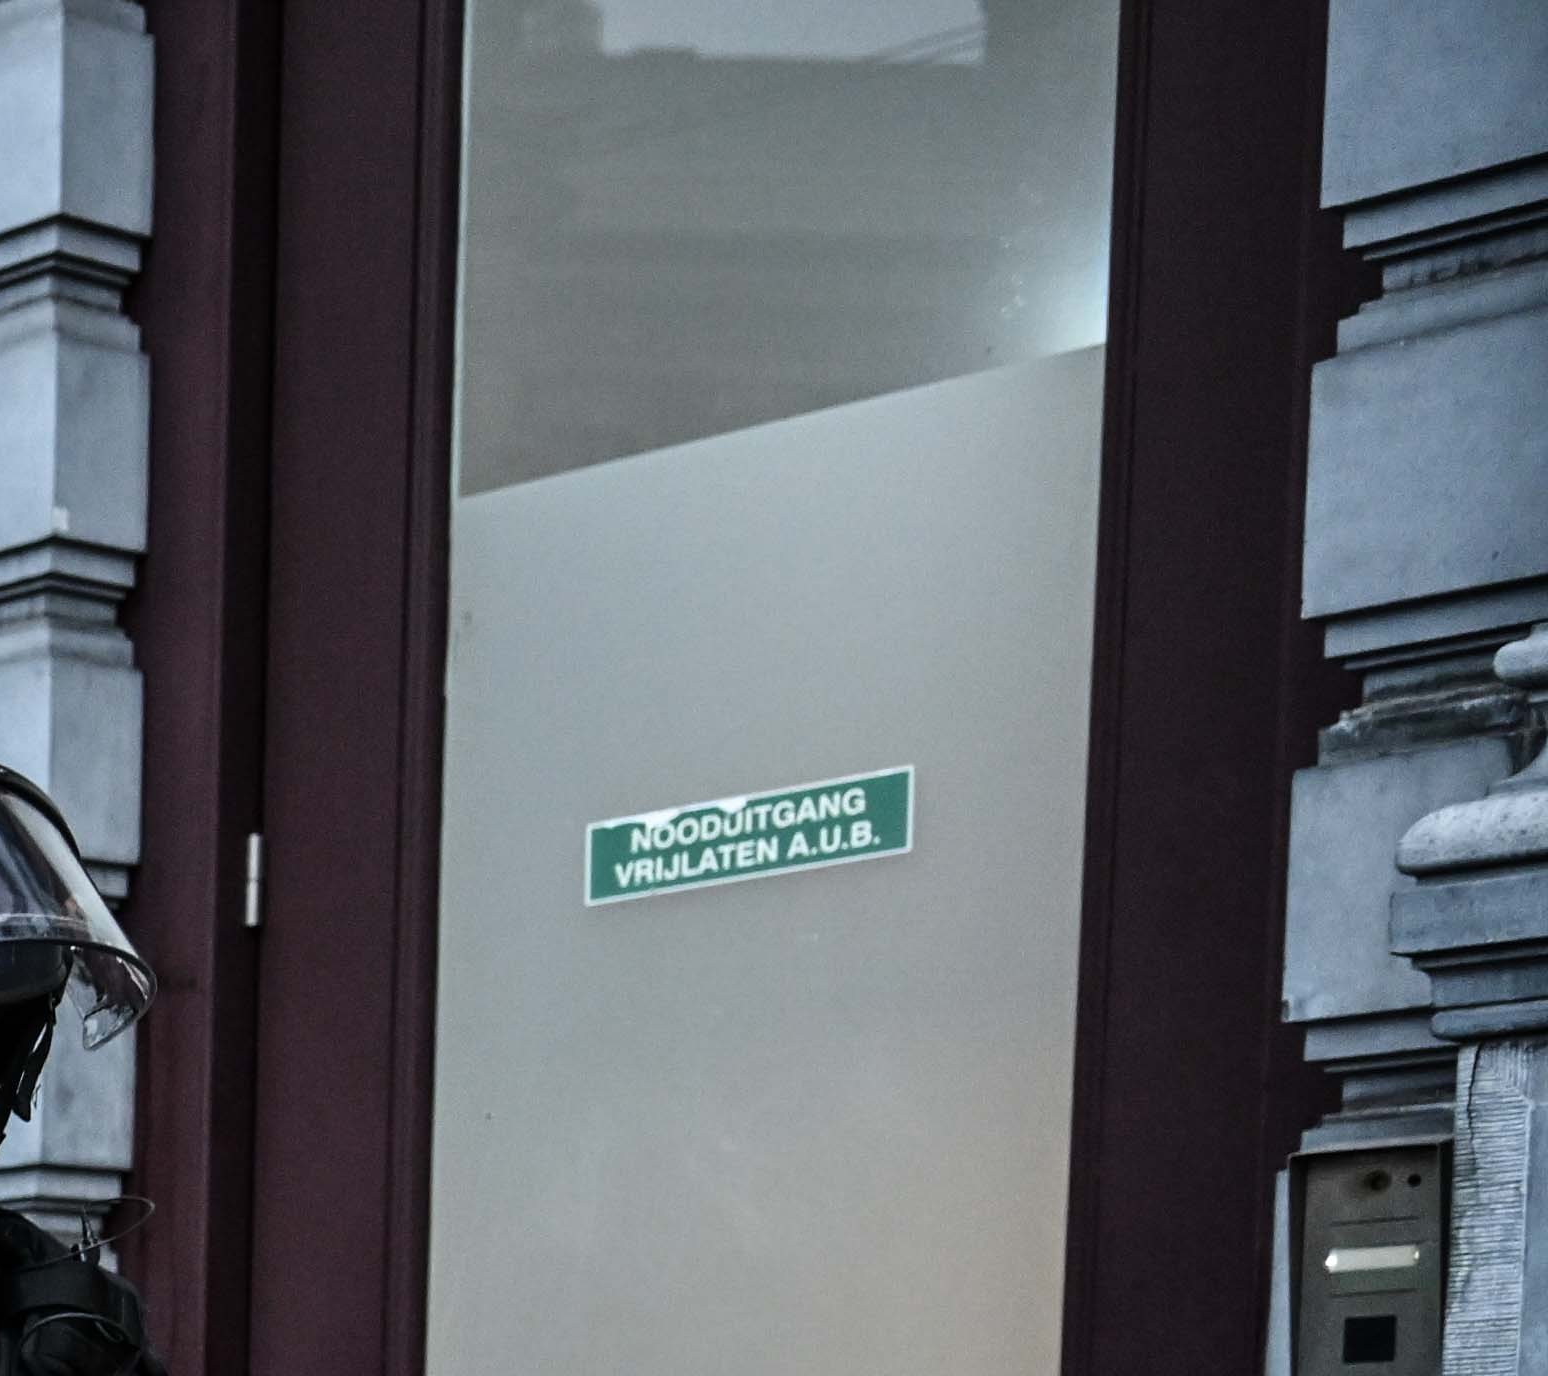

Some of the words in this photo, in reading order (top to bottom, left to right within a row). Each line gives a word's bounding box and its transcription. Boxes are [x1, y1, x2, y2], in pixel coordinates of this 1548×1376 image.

[630, 788, 867, 854] NOODUITGANG
[614, 836, 779, 888] VRIJLATEN
[787, 821, 882, 857] A.U.B.
